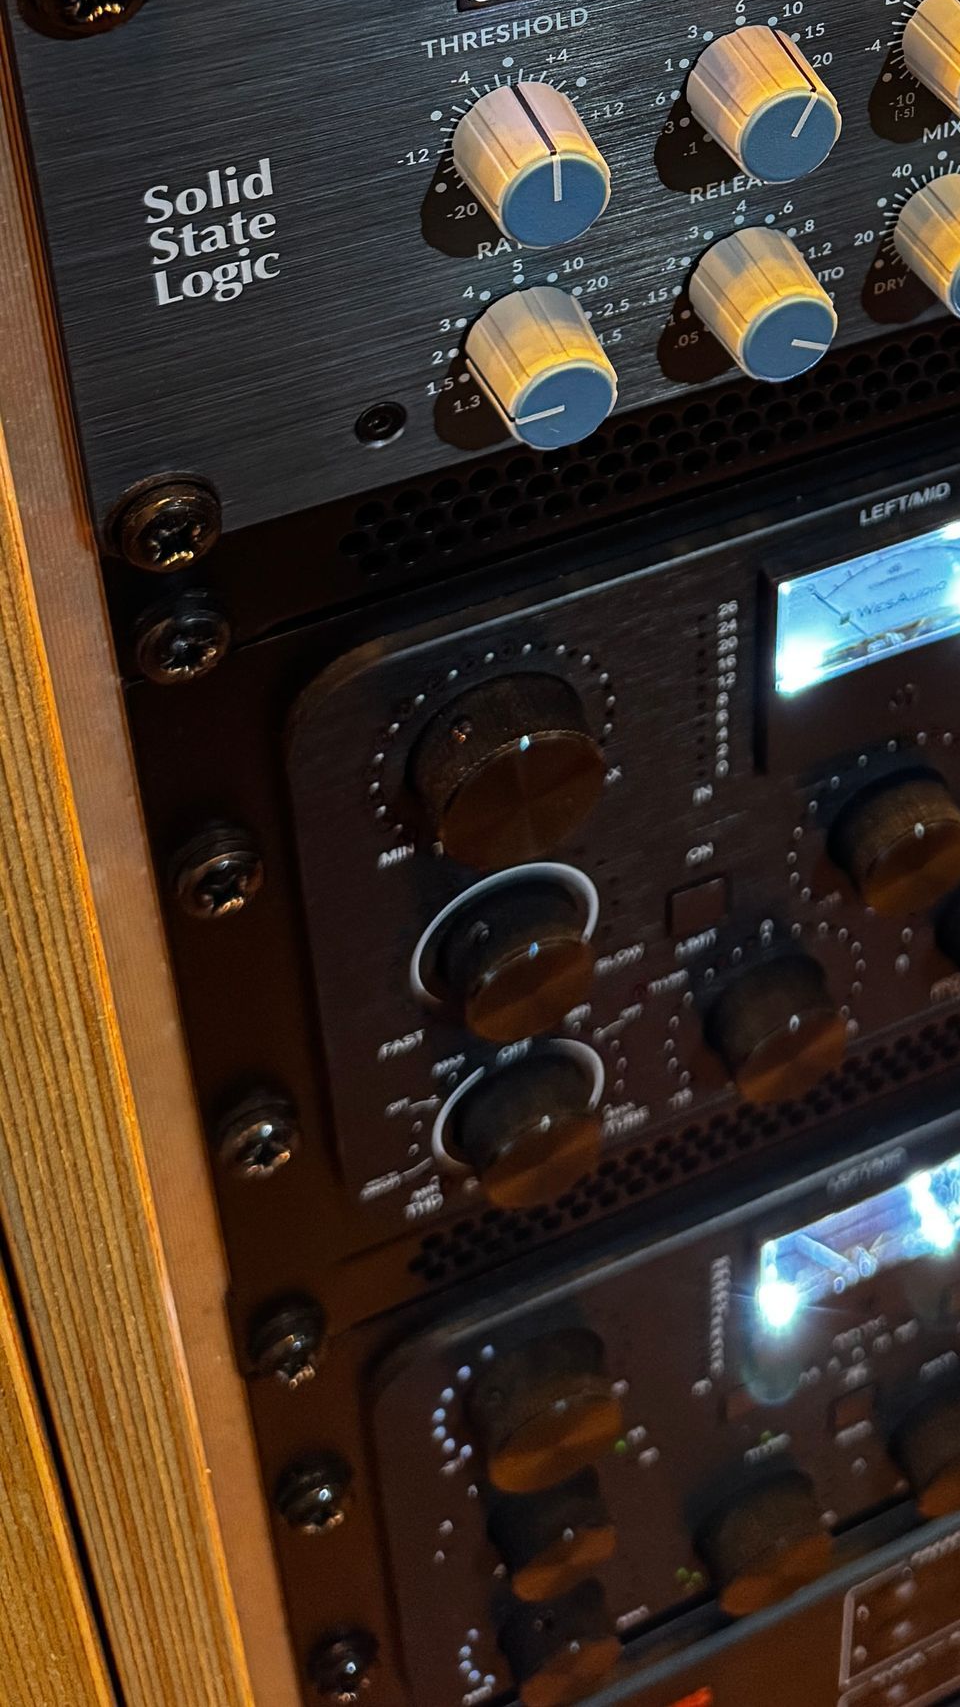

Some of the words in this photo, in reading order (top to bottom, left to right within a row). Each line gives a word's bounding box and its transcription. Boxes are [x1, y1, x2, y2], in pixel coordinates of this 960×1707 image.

[422, 7, 589, 59] THRESHOLD
[397, 148, 430, 167] -12
[143, 157, 274, 224] Solid
[149, 211, 277, 265] State
[854, 229, 874, 247] 20
[153, 248, 281, 306] Logic
[859, 481, 952, 526] LEFT/MID
[378, 843, 416, 869] MIN
